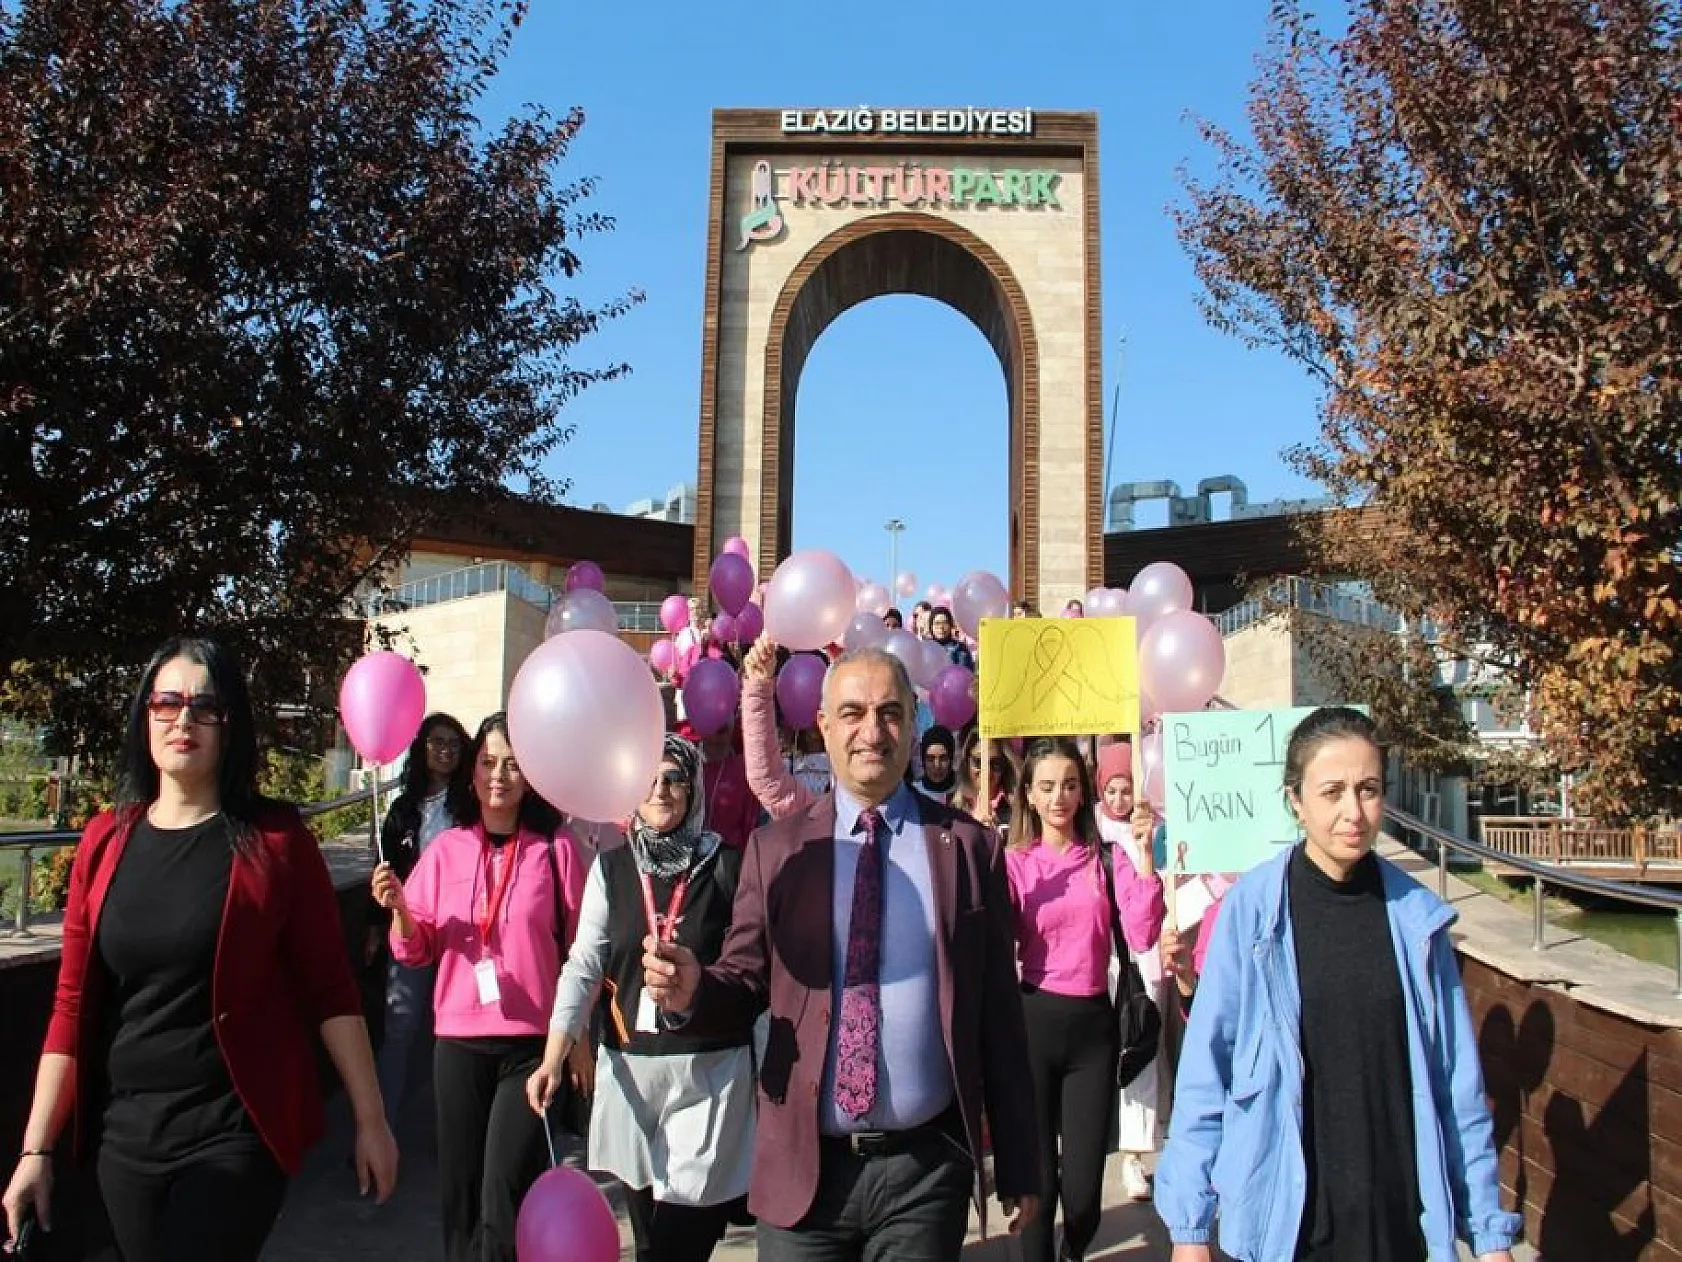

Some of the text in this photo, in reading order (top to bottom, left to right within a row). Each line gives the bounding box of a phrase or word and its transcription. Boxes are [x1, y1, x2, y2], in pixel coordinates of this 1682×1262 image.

[781, 105, 1032, 133] ELAZIĞ BELEDİYESİ
[788, 161, 1060, 206] KÜLTÜRPARK
[1174, 722, 1241, 767] Bugün
[1174, 781, 1254, 823] YARIN
